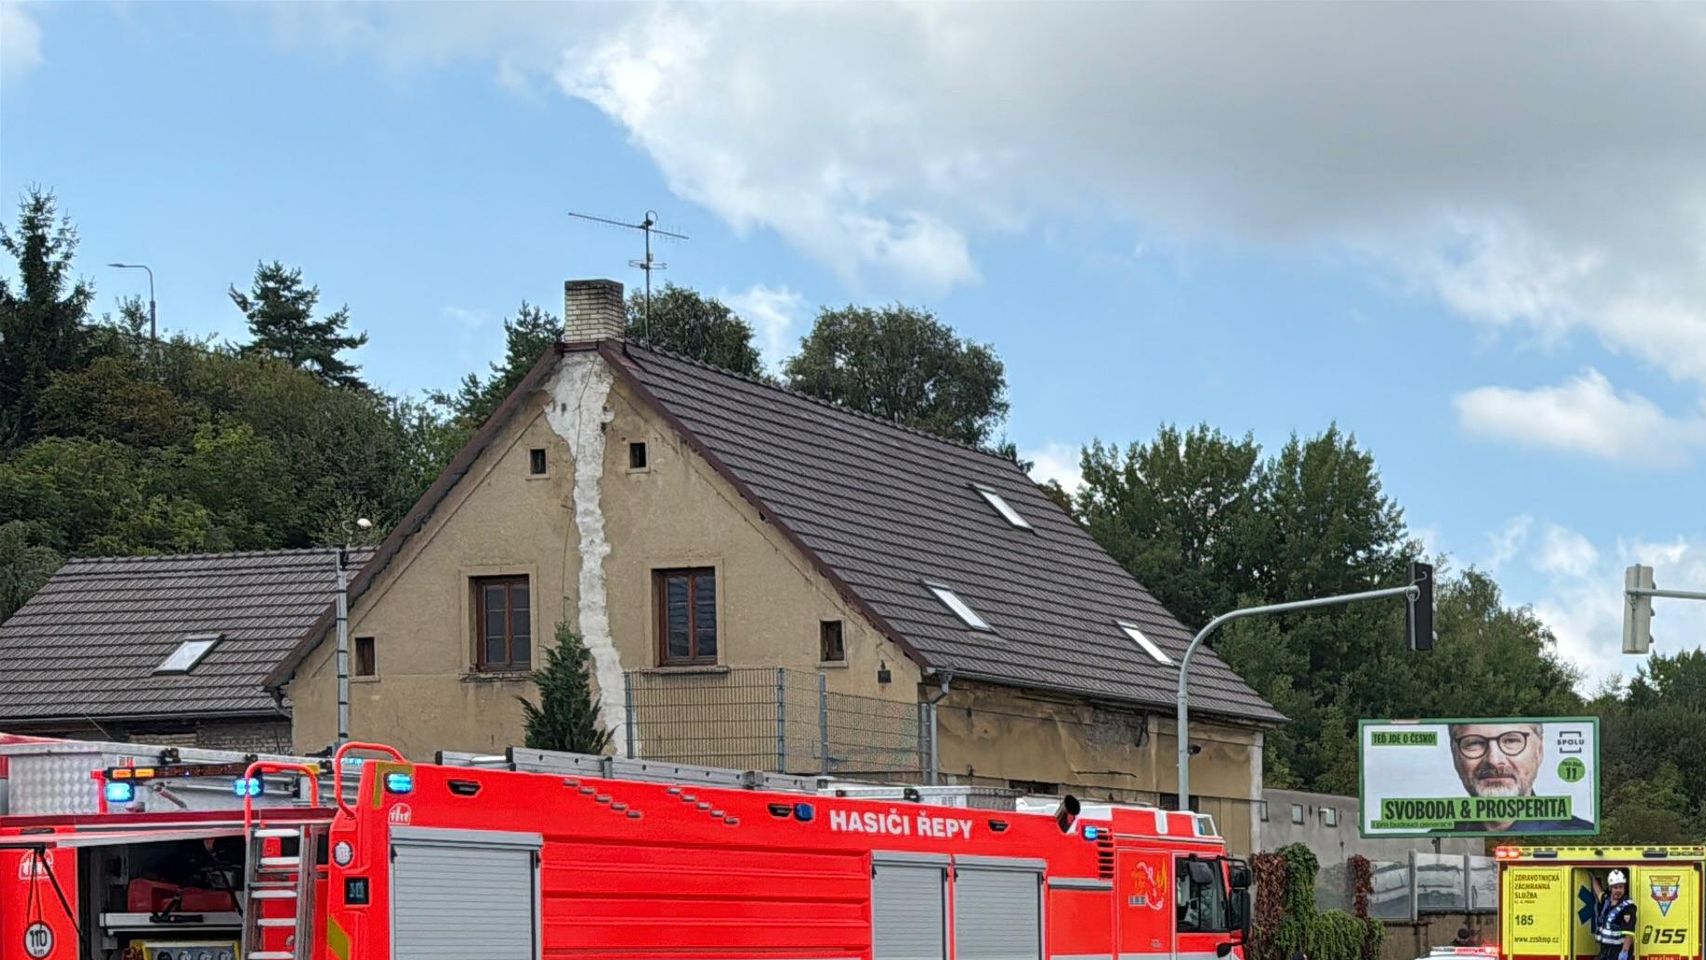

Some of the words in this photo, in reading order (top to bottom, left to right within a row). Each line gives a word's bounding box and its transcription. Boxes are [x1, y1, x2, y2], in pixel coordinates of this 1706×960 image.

[1403, 733, 1408, 744] O
[1566, 766, 1577, 780] 11
[1385, 800, 1456, 820] SVOBODA
[1460, 800, 1472, 819] &
[1475, 798, 1568, 818] PROSPERITA
[829, 807, 911, 835] HASIČI
[916, 809, 973, 840] ŘEPY
[1515, 914, 1534, 926] 185
[30, 929, 48, 947] 110
[1653, 928, 1688, 944] 155
